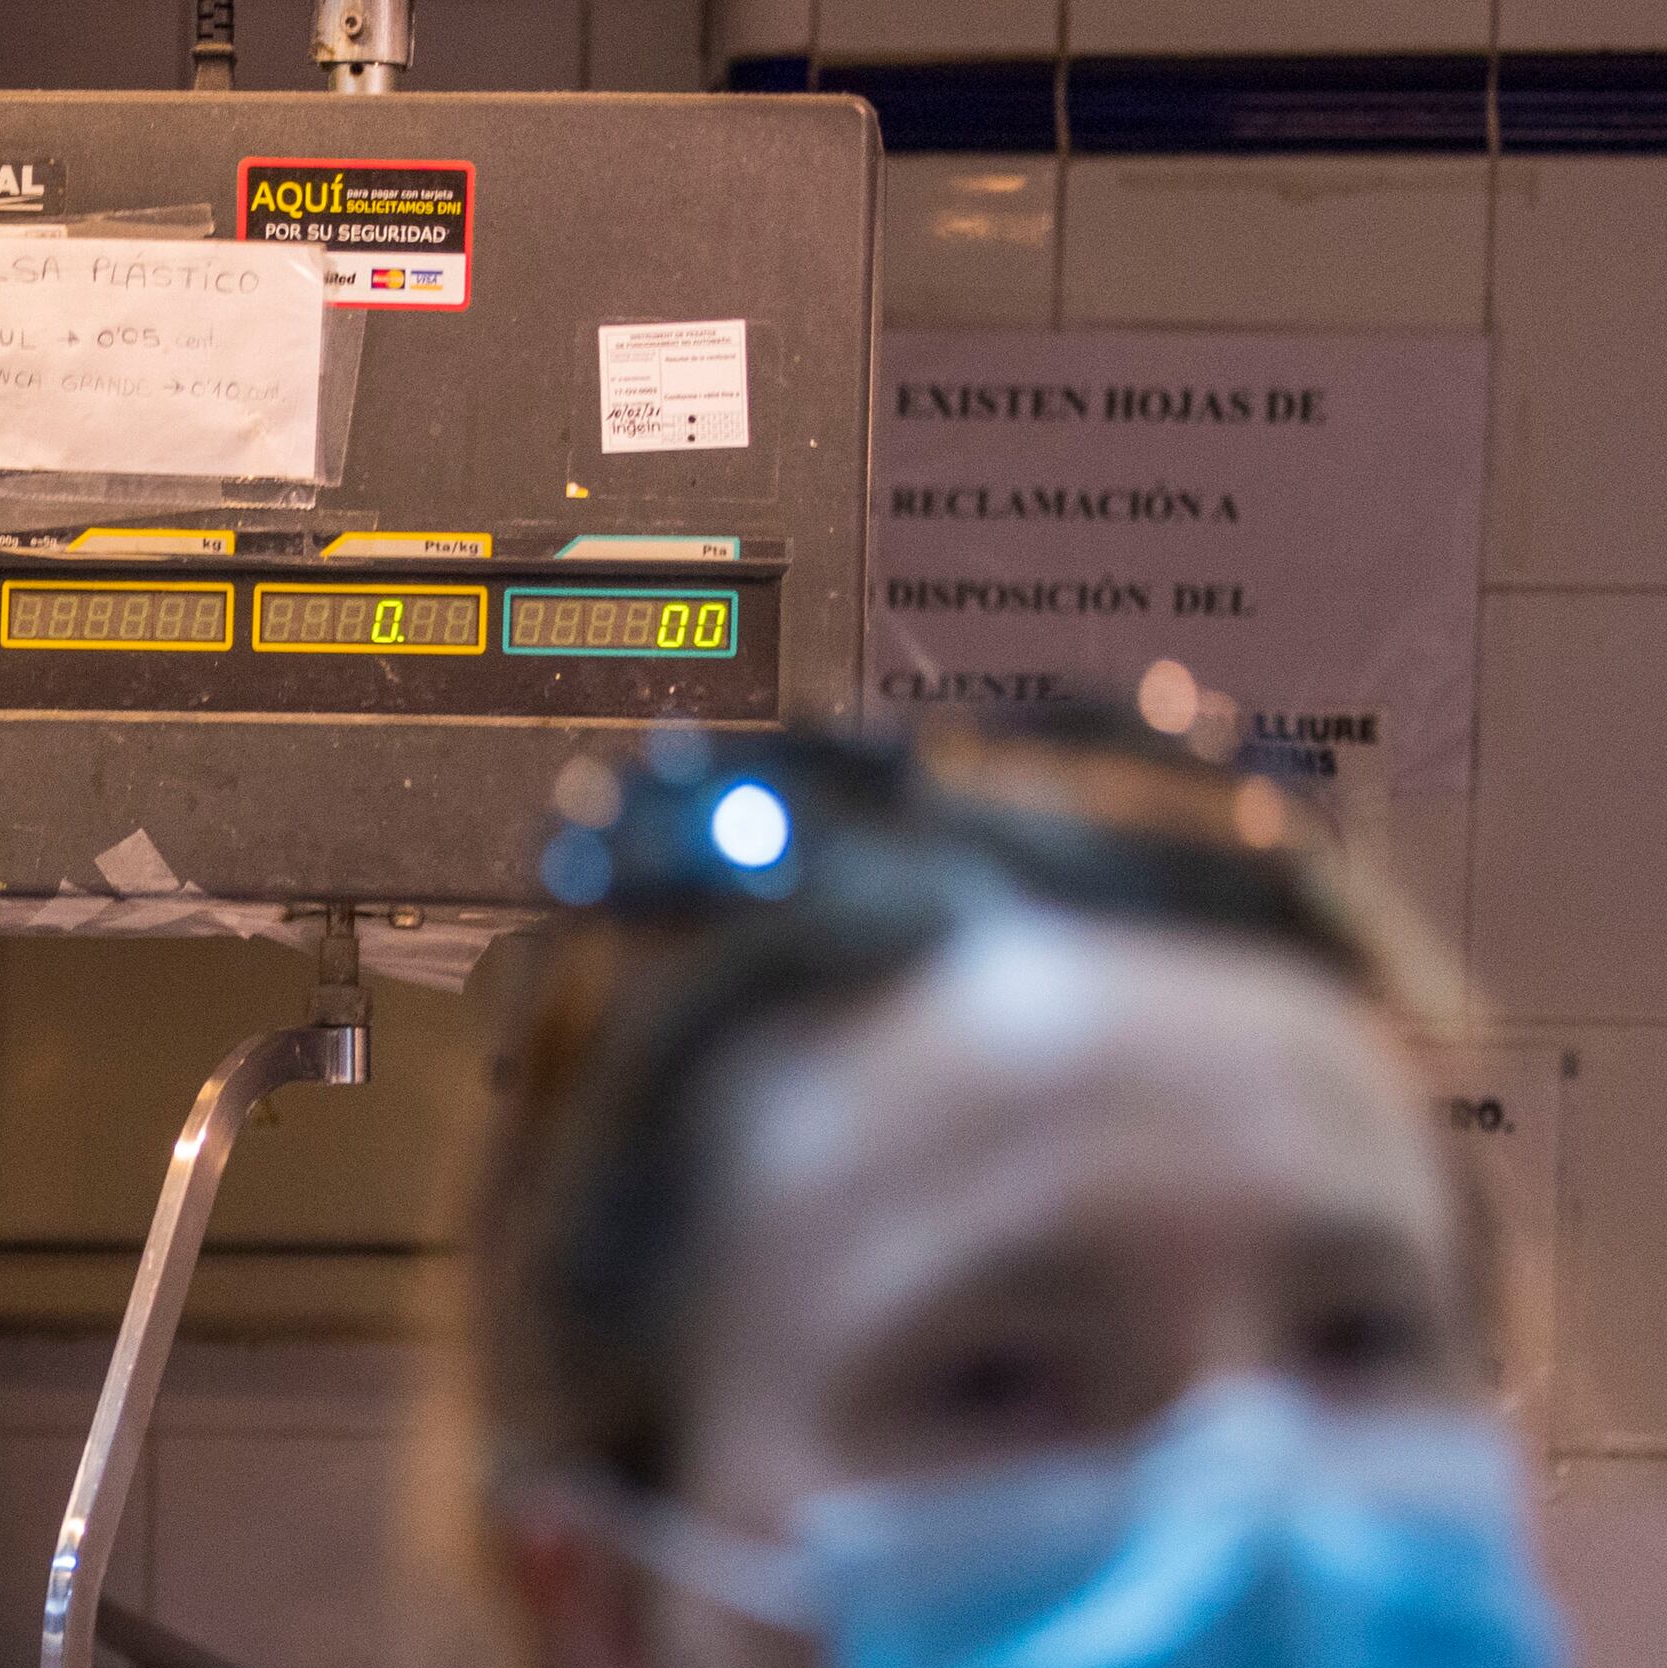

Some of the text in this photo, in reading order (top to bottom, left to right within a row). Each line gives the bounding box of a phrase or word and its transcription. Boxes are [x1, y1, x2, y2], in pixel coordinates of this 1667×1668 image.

[250, 173, 344, 219] AQUÍ
[346, 188, 454, 201] para pagar con tarjeta
[346, 200, 462, 216] SOLICITAMOS DNI
[265, 223, 447, 244] POR SU SEGURIDAD
[895, 383, 1325, 424] EXISTEN HOJAS DE
[891, 483, 1241, 523] RECLAMACIÓN A
[202, 537, 222, 551] kg
[424, 540, 480, 556] Pta/kg
[702, 544, 728, 556] Pta
[885, 575, 1256, 618] DISPOSICIÓN DEL
[656, 603, 727, 649] 00
[1254, 713, 1379, 745] LLIURE
